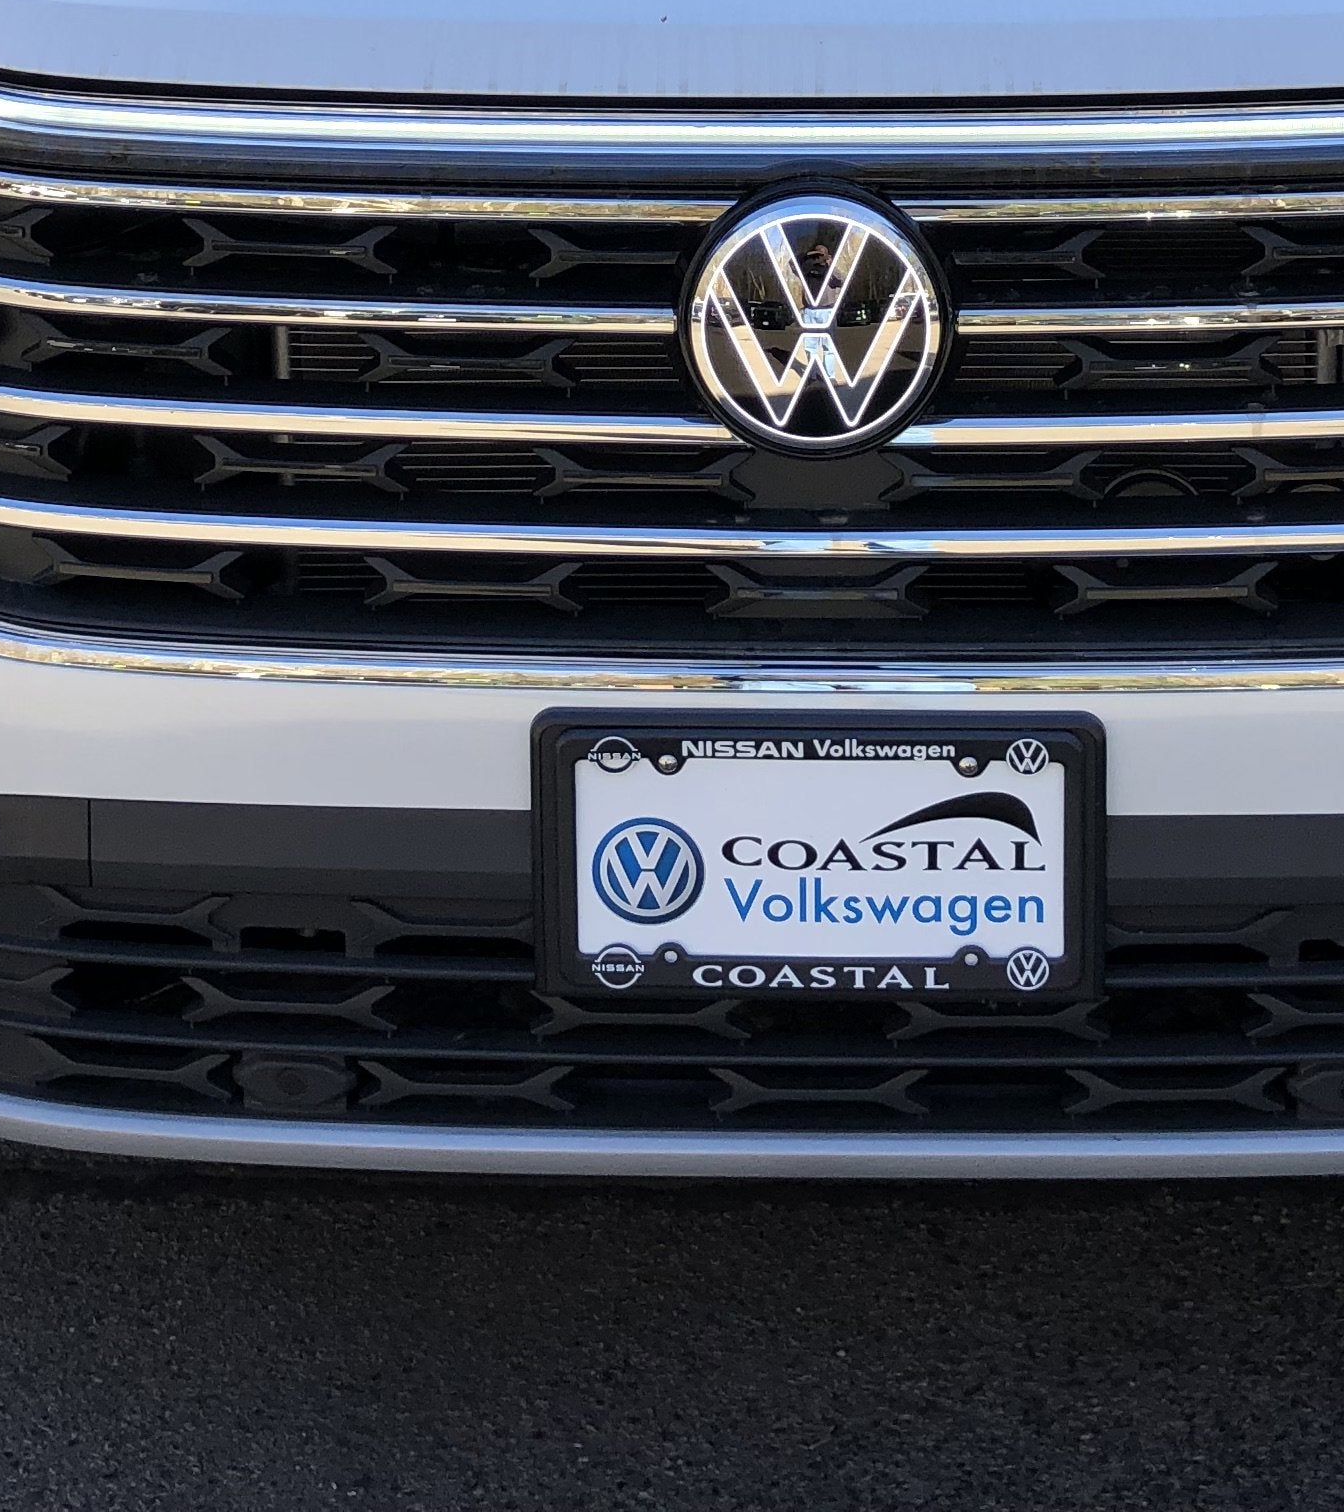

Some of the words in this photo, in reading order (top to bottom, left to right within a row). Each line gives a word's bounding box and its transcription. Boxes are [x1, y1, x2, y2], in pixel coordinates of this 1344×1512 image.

[587, 752, 642, 760] NISSAN
[681, 740, 805, 758] NISSAN
[813, 738, 956, 761] Volkswagen
[721, 836, 1046, 872] COASTAL
[723, 877, 1045, 936] Volkswagen
[591, 963, 645, 973] NISSAN
[692, 964, 950, 990] COASTAL
